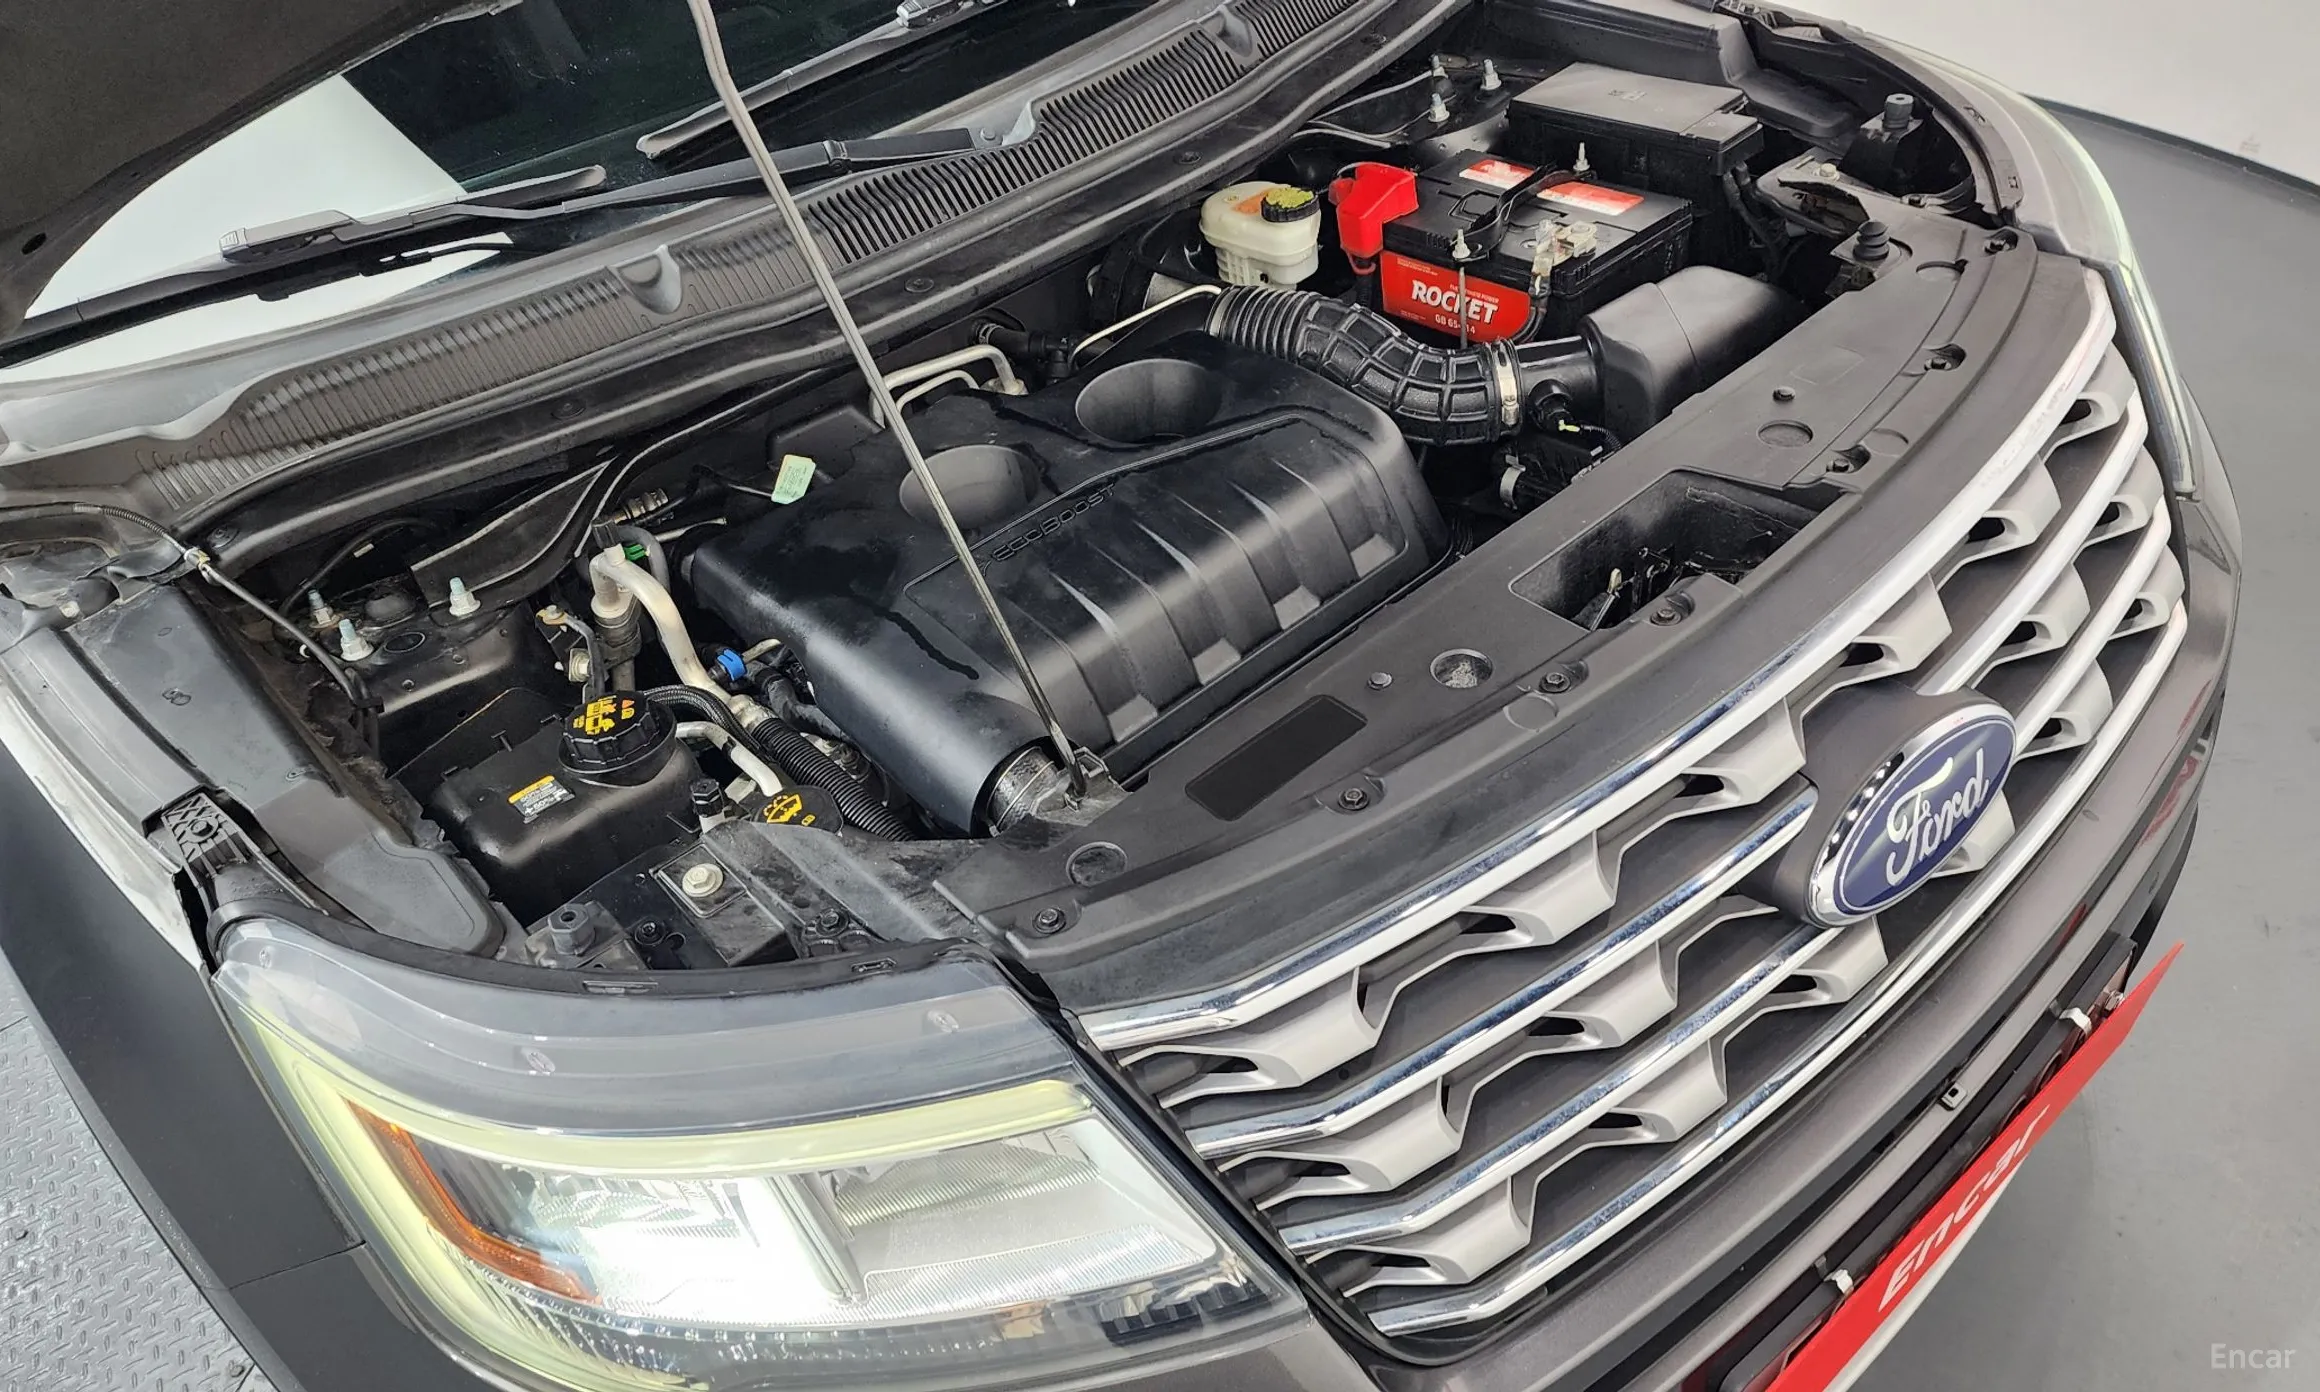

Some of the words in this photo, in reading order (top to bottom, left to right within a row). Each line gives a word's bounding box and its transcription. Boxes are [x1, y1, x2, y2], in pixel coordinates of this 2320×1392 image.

[1411, 279, 1499, 324] ROCKET
[992, 483, 1115, 562] ECOBOOST
[1886, 747, 1990, 886] Ford
[1878, 1103, 2051, 1313] Encar
